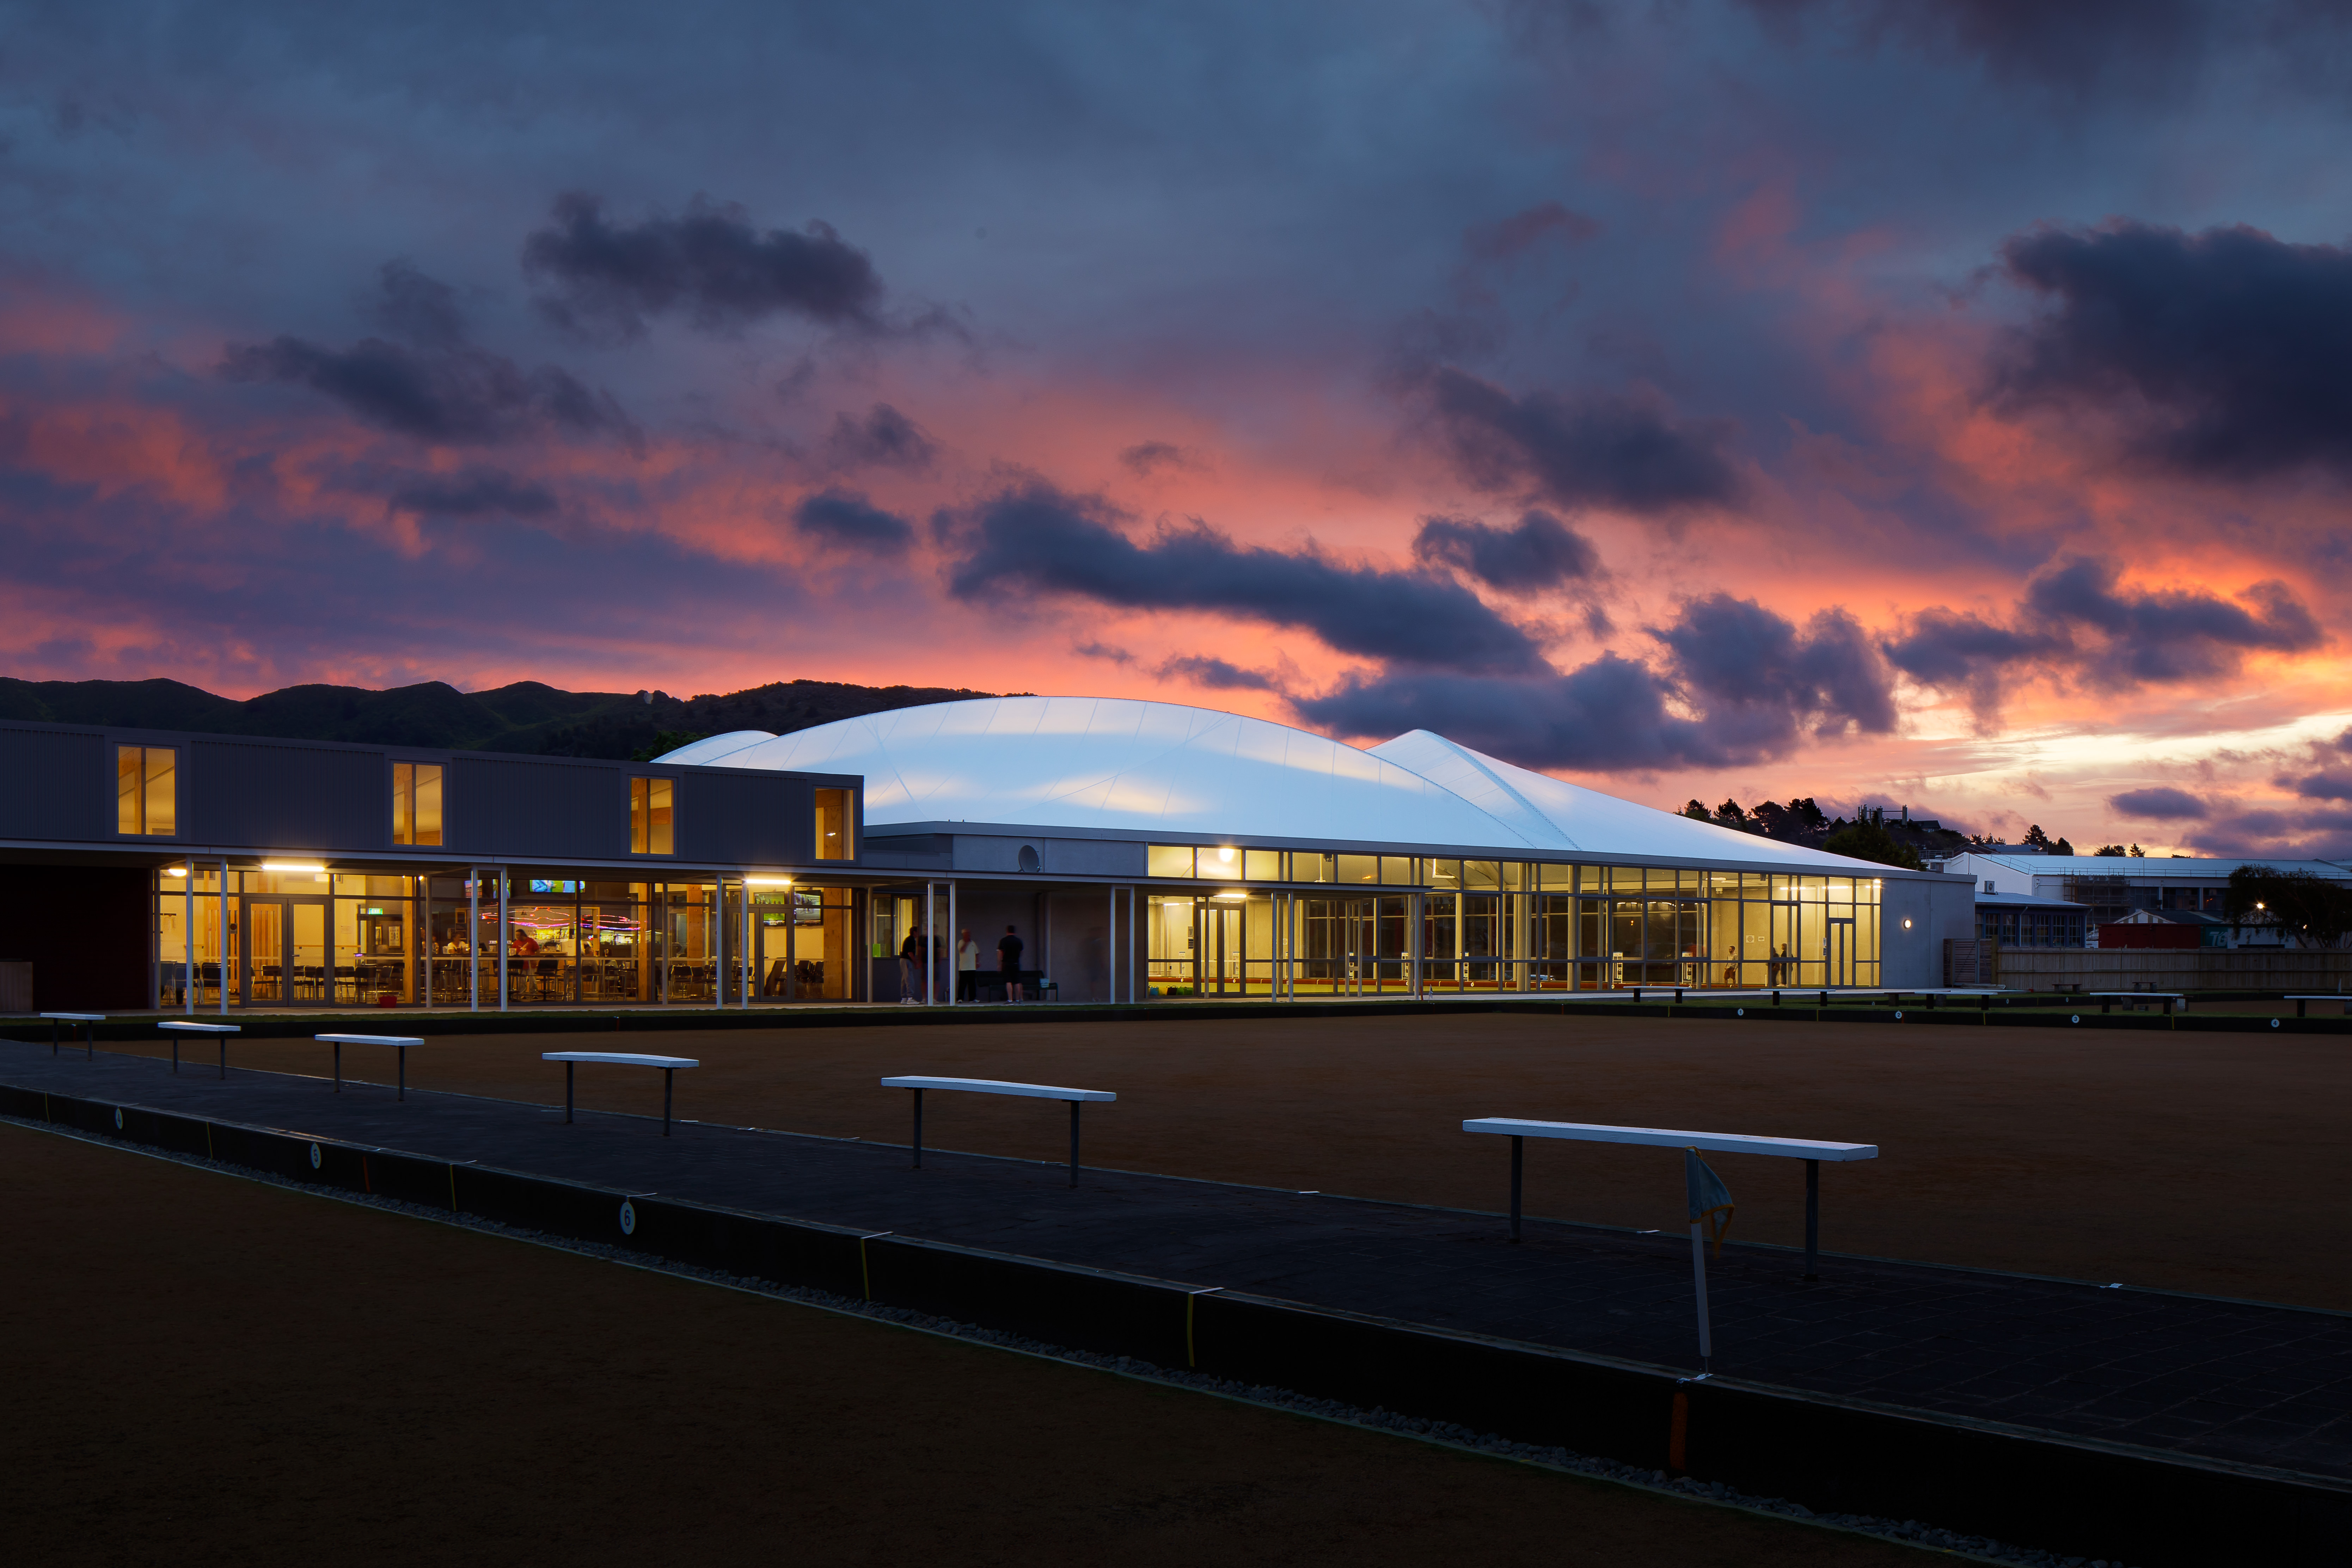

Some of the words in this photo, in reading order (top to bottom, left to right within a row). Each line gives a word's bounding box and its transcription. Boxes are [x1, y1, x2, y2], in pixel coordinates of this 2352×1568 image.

[117, 1113, 121, 1124] 4
[313, 1149, 318, 1162] 5
[624, 1209, 631, 1226] 6
